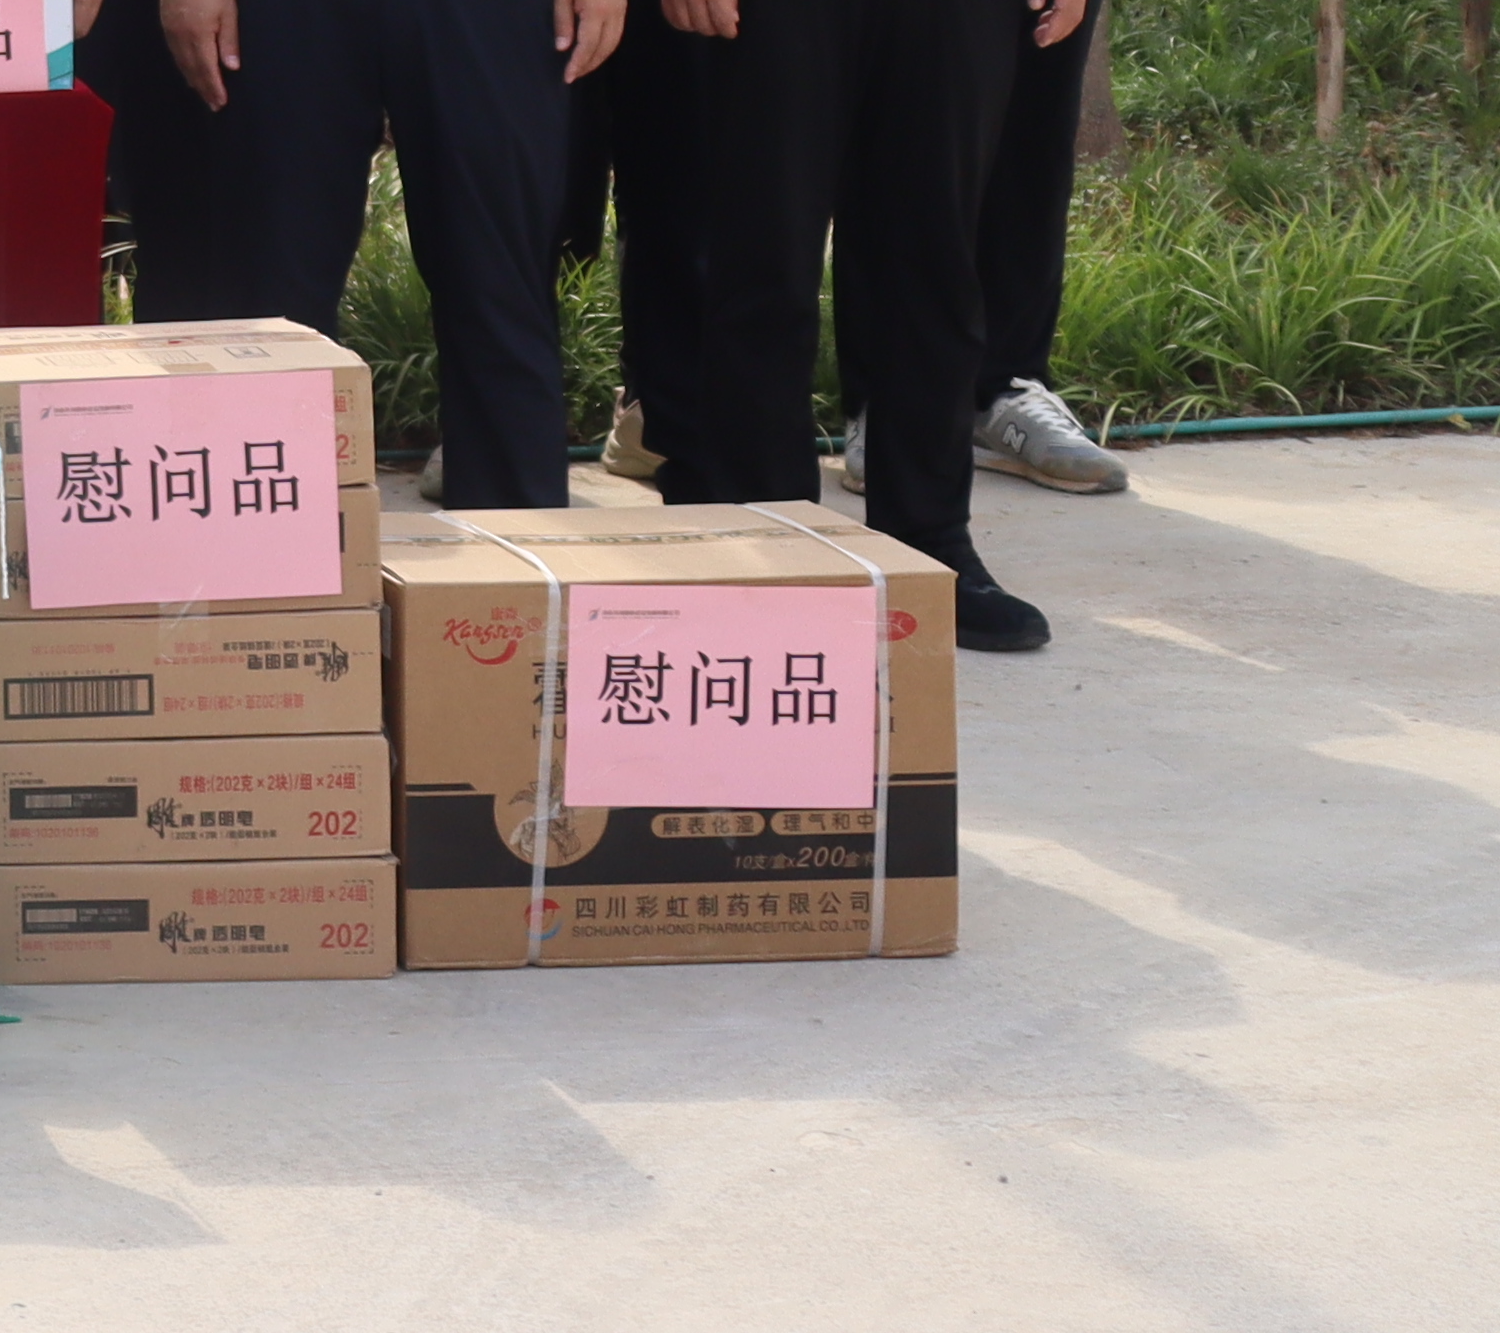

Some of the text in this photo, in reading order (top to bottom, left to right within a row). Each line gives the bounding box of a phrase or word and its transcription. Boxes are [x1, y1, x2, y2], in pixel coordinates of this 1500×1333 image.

[57, 440, 300, 523] 慰问品
[598, 650, 837, 726] 慰问品
[308, 810, 357, 837] 202
[663, 811, 875, 834] 解表化湿 理气和中
[576, 891, 871, 919] 四川彩虹制药有限公司
[320, 923, 369, 949] 202
[572, 924, 631, 937] SICHUAN
[698, 921, 817, 935] PHARMACEUTICAL
